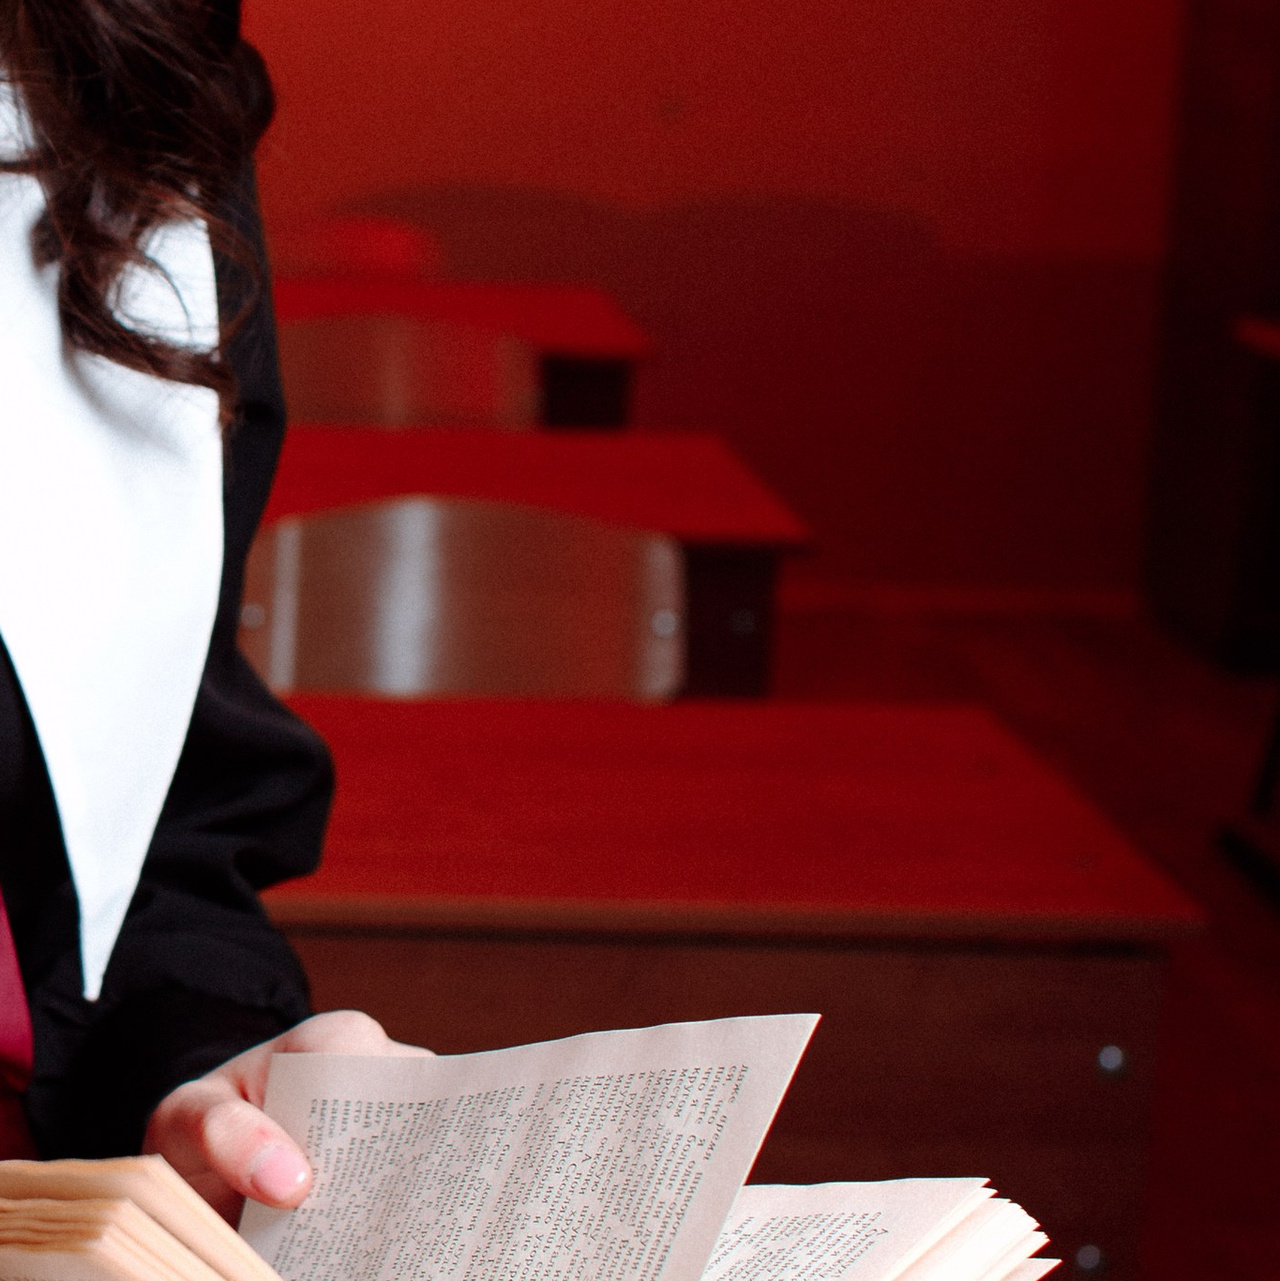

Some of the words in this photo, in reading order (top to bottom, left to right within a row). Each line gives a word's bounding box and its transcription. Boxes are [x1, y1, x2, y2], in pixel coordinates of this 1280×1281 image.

[512, 1084, 526, 1102] он
[556, 1075, 582, 1119] шоссе
[605, 1071, 636, 1123] внутри
[627, 1069, 657, 1119] дество
[646, 1067, 678, 1119] просто
[663, 1067, 689, 1110] место
[669, 1065, 701, 1119] кругом
[694, 1064, 726, 1125] планете
[695, 1066, 714, 1092] что
[719, 1064, 738, 1086] ся,
[724, 1063, 750, 1104] даже
[508, 1106, 529, 1133] Это
[520, 1106, 546, 1146] Томас
[550, 1074, 606, 1175] Наслаждайся
[573, 1073, 617, 1154] хватывает!
[610, 1091, 638, 1134] руках
[628, 1067, 668, 1144] смахивает
[705, 1098, 724, 1125] что
[481, 1112, 515, 1165] держал
[491, 1142, 514, 1171] был
[517, 1111, 552, 1170] спасибо
[525, 1116, 556, 1169] полном
[644, 1122, 666, 1150] для
[663, 1133, 700, 1190] больше
[699, 1113, 729, 1161] время
[490, 1154, 523, 1213] покатил
[517, 1124, 561, 1206] проложено
[527, 1139, 567, 1203] Господи,
[576, 1135, 610, 1196] осколки
[586, 1146, 615, 1193] такую
[593, 1127, 634, 1203] семьдесят
[609, 1126, 656, 1216] счастливый
[616, 1154, 632, 1173] на
[623, 1129, 676, 1228] здоровенное!
[631, 1132, 687, 1238] восьмилетний
[460, 1176, 486, 1213] руль,
[463, 1181, 495, 1232] долгий
[491, 1180, 530, 1245] порядке!
[538, 1171, 583, 1253] поглядишь
[539, 1184, 555, 1204] им
[541, 1161, 581, 1225] Сколько
[583, 1182, 620, 1246] вещицу,
[614, 1162, 649, 1223] старого
[650, 1199, 667, 1219] ни
[475, 1190, 518, 1267] спокойной
[479, 1220, 494, 1238] по
[515, 1212, 532, 1231] да
[519, 1234, 534, 1251] не
[537, 1209, 578, 1281] хрусталя,
[559, 1204, 590, 1255] штуку:
[580, 1213, 598, 1237] лет
[588, 1225, 613, 1264] стал.
[434, 1224, 465, 1274] иногда
[443, 1242, 467, 1276] путь
[625, 1228, 654, 1274] души.
